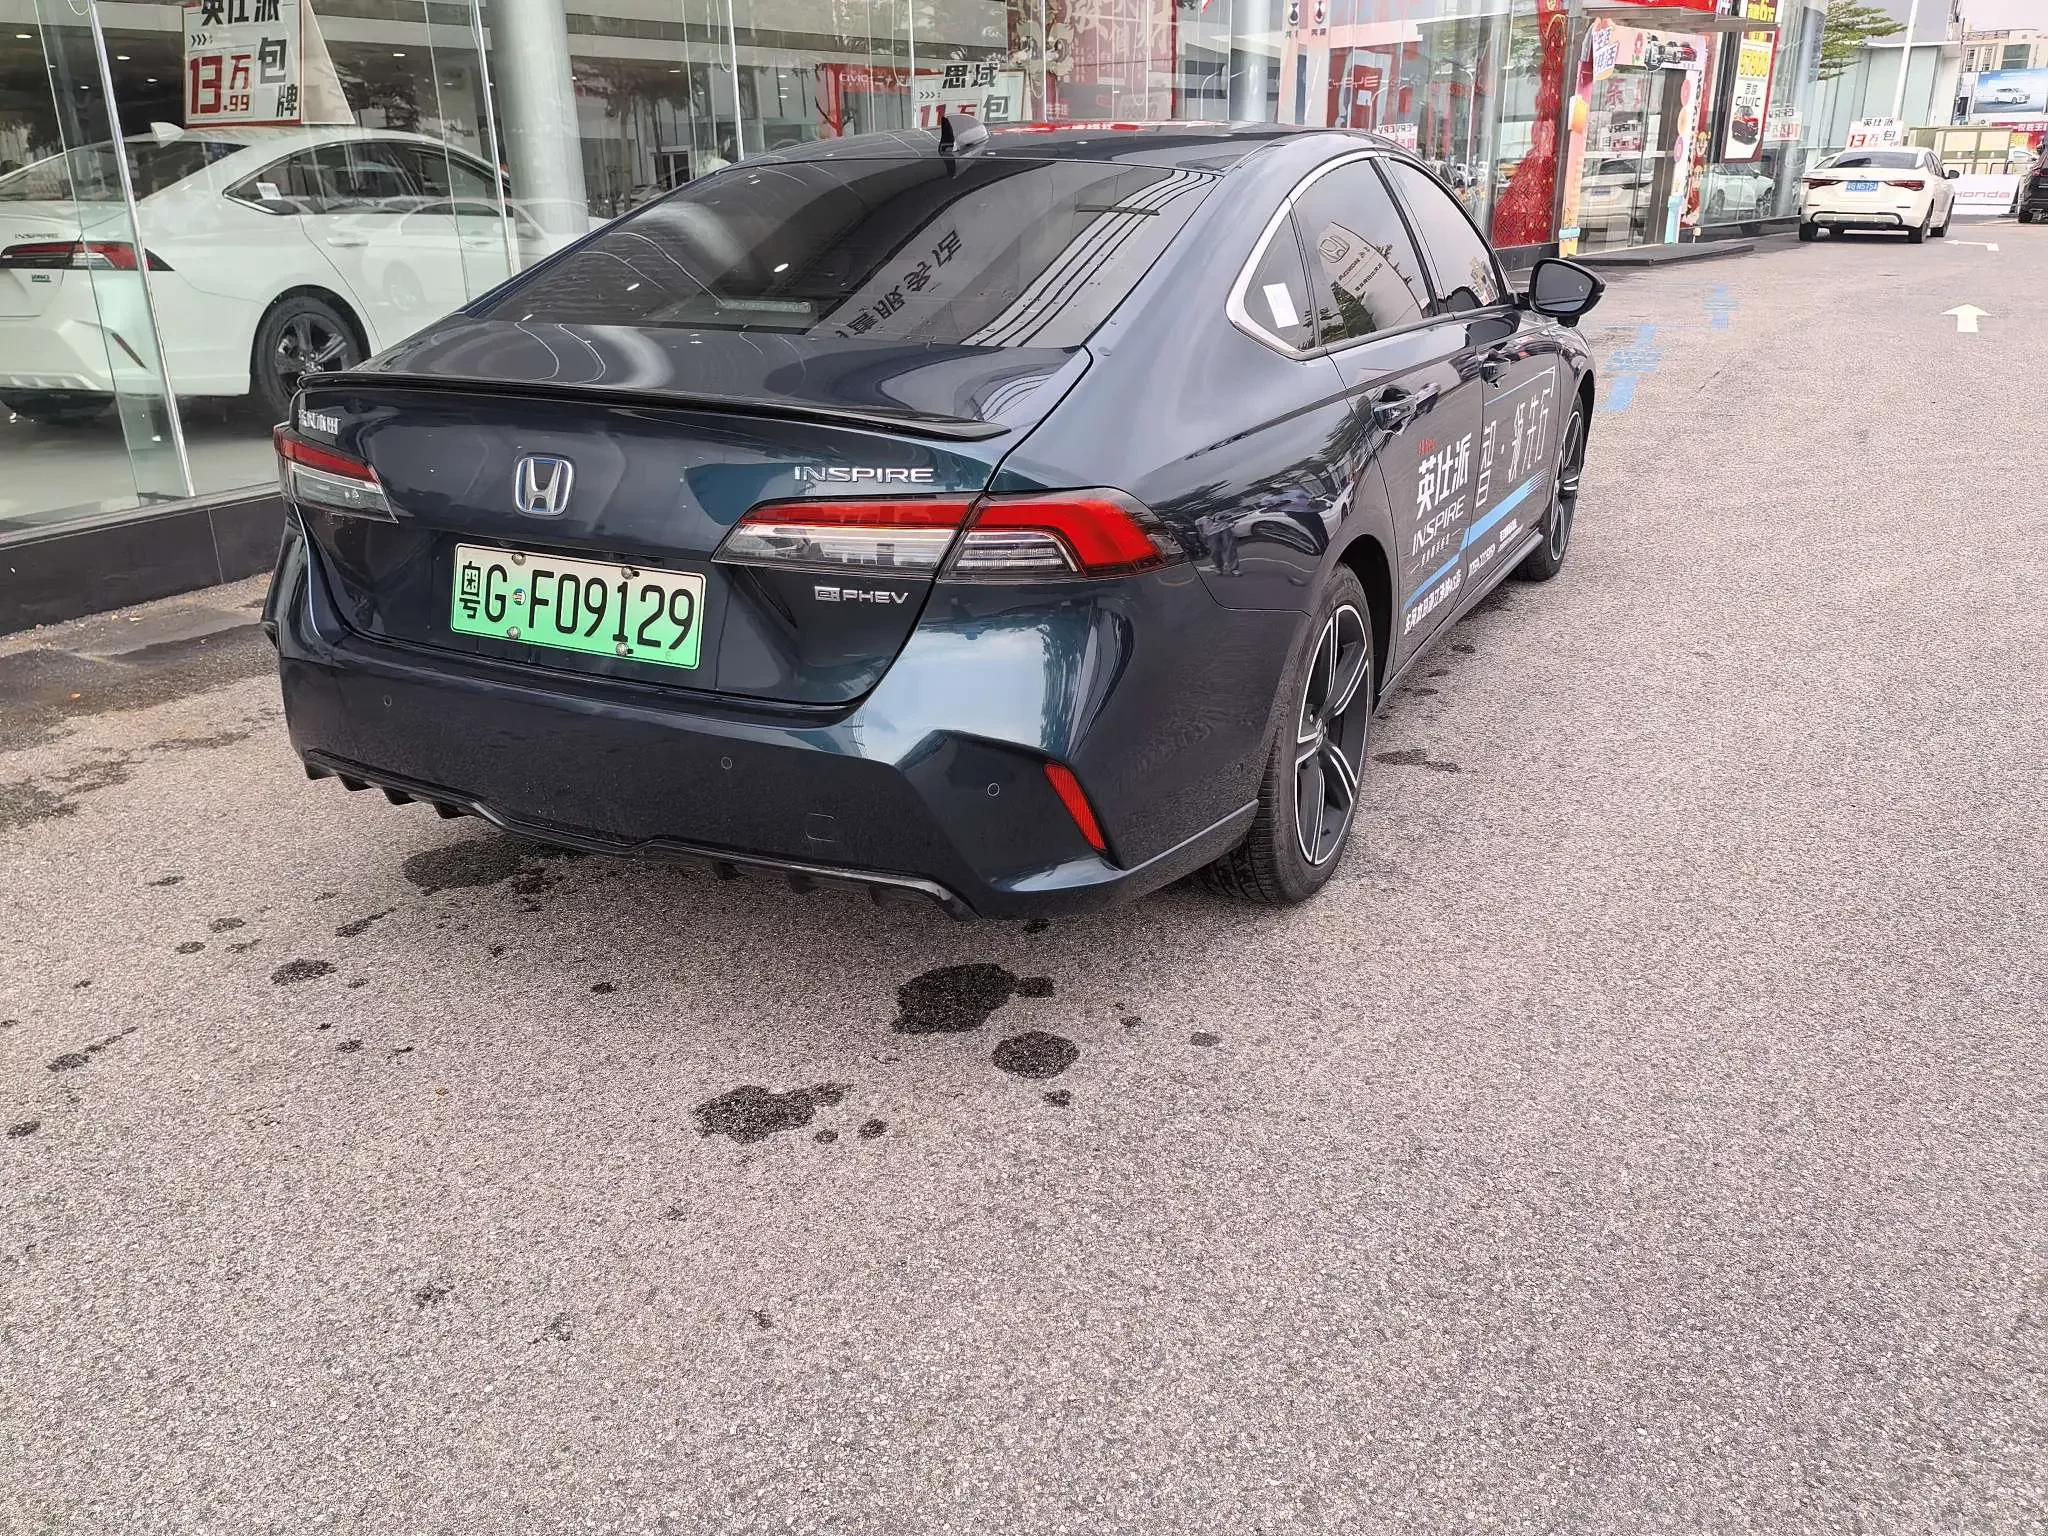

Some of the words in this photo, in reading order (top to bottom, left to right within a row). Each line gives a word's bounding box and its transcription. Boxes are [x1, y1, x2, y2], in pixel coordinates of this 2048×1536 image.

[258, 37, 287, 84] 包
[942, 63, 998, 89] 思域
[276, 83, 298, 118] 牌
[983, 94, 1010, 121] 包
[794, 466, 935, 483] INSPIRE
[1416, 432, 1473, 521] 英仕派
[1411, 494, 1467, 557] INSPIRE
